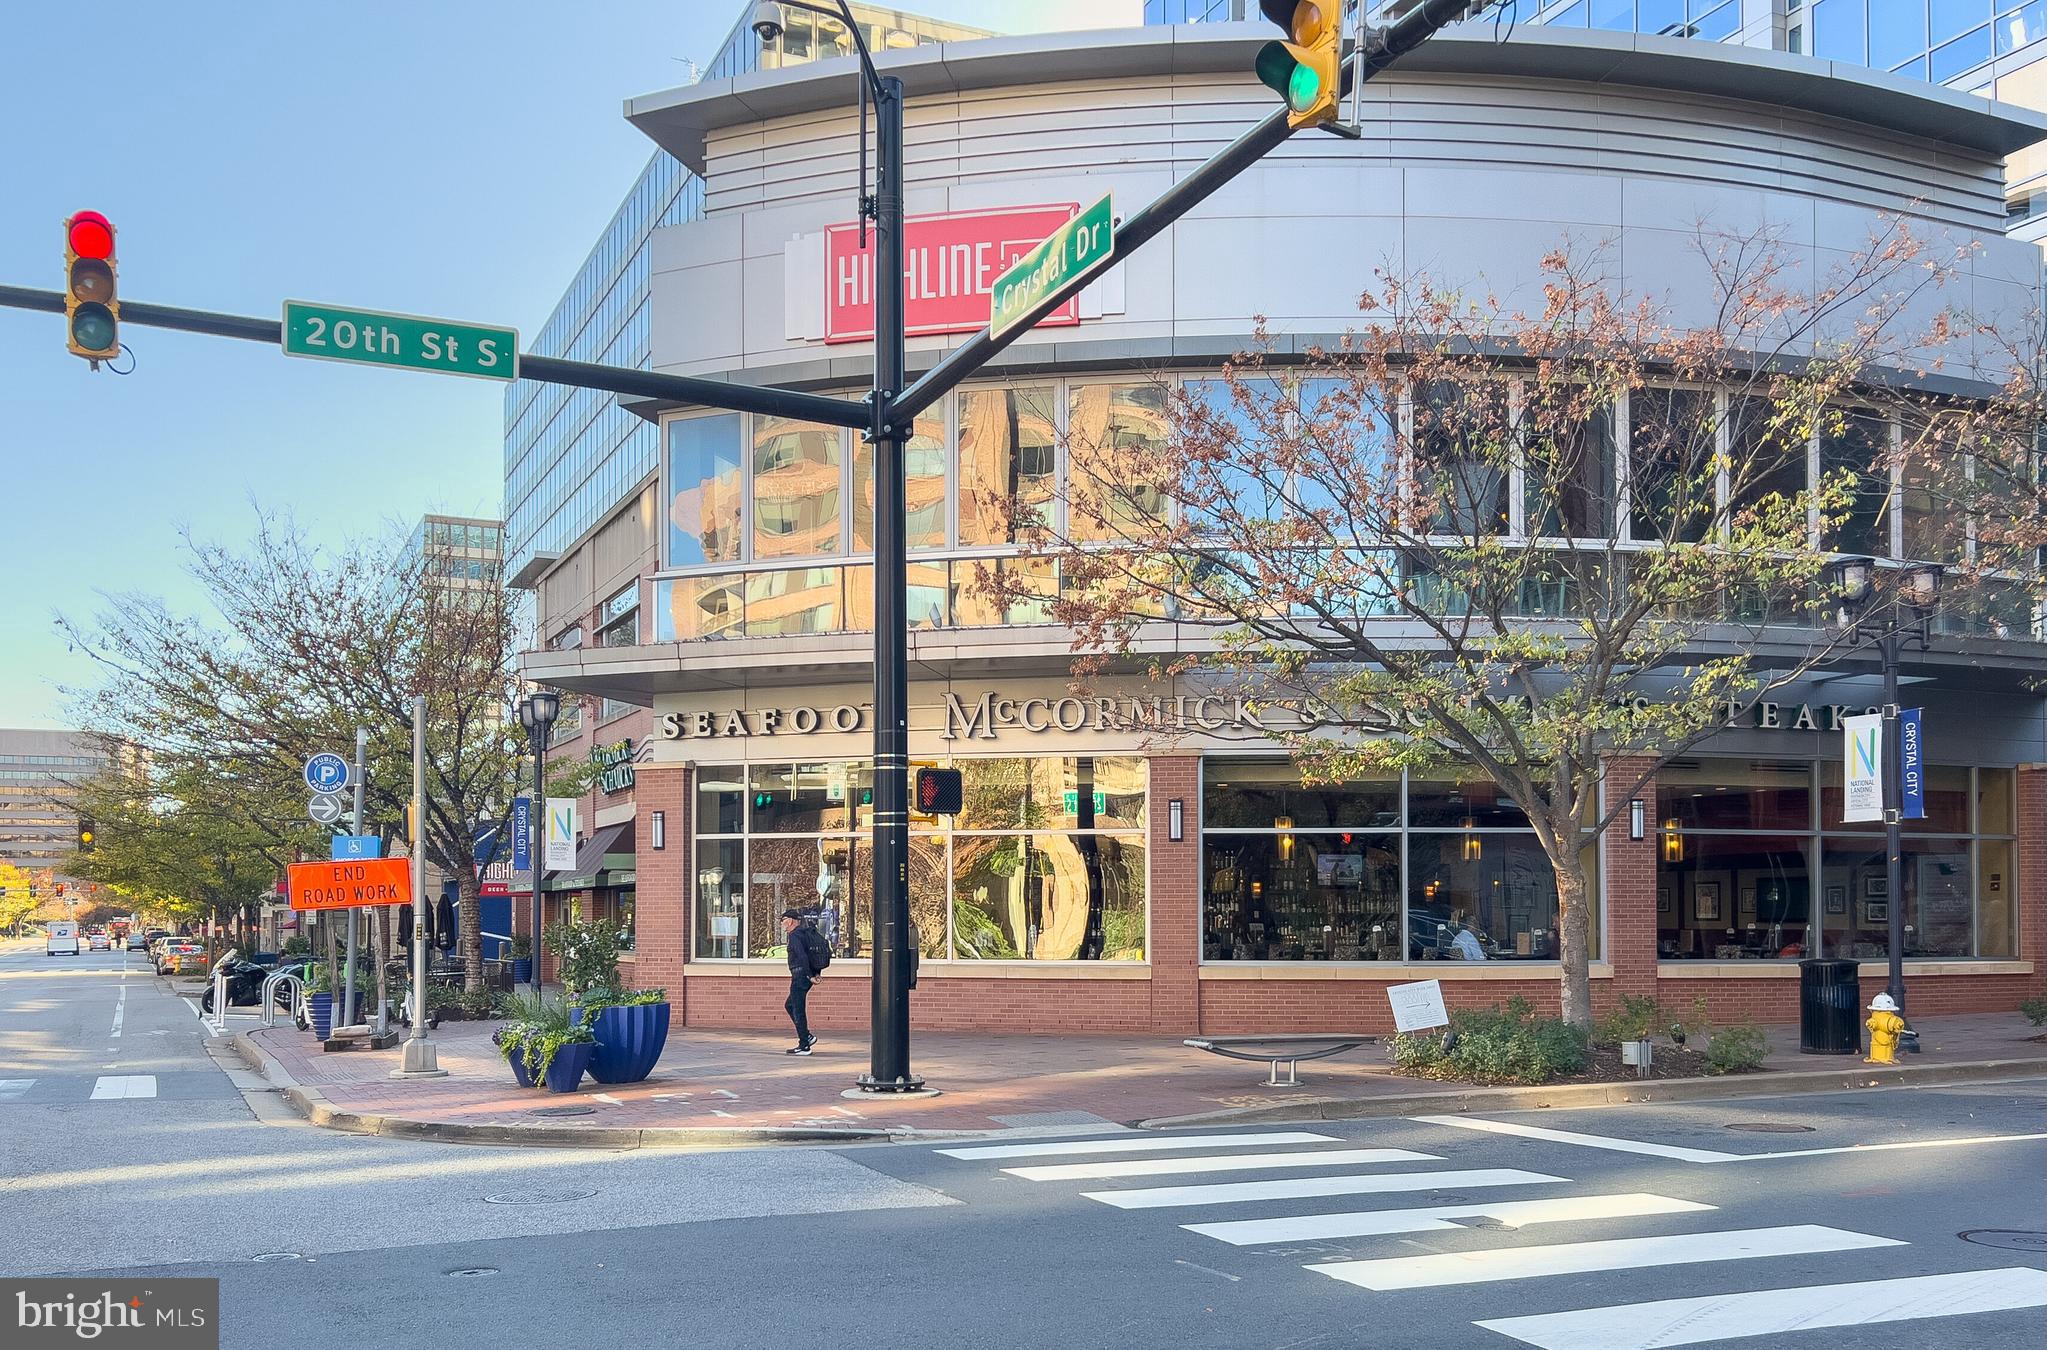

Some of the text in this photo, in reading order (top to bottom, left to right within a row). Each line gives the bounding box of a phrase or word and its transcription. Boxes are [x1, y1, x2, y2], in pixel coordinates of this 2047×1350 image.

[838, 241, 993, 307] HIHLINE
[1002, 222, 1100, 314] Crystal Dr
[305, 317, 498, 367] 20th St S
[661, 703, 873, 740] SEAFOO
[313, 756, 341, 767] PUBLIC
[320, 766, 335, 781] P
[1905, 722, 1918, 797] CRYSTAL CITY
[310, 779, 342, 791] PARKING
[1850, 779, 1875, 787] NATIONAL
[517, 806, 526, 856] CRYSTAL CITY
[334, 866, 365, 882] END
[304, 884, 398, 904] ROAD WORK
